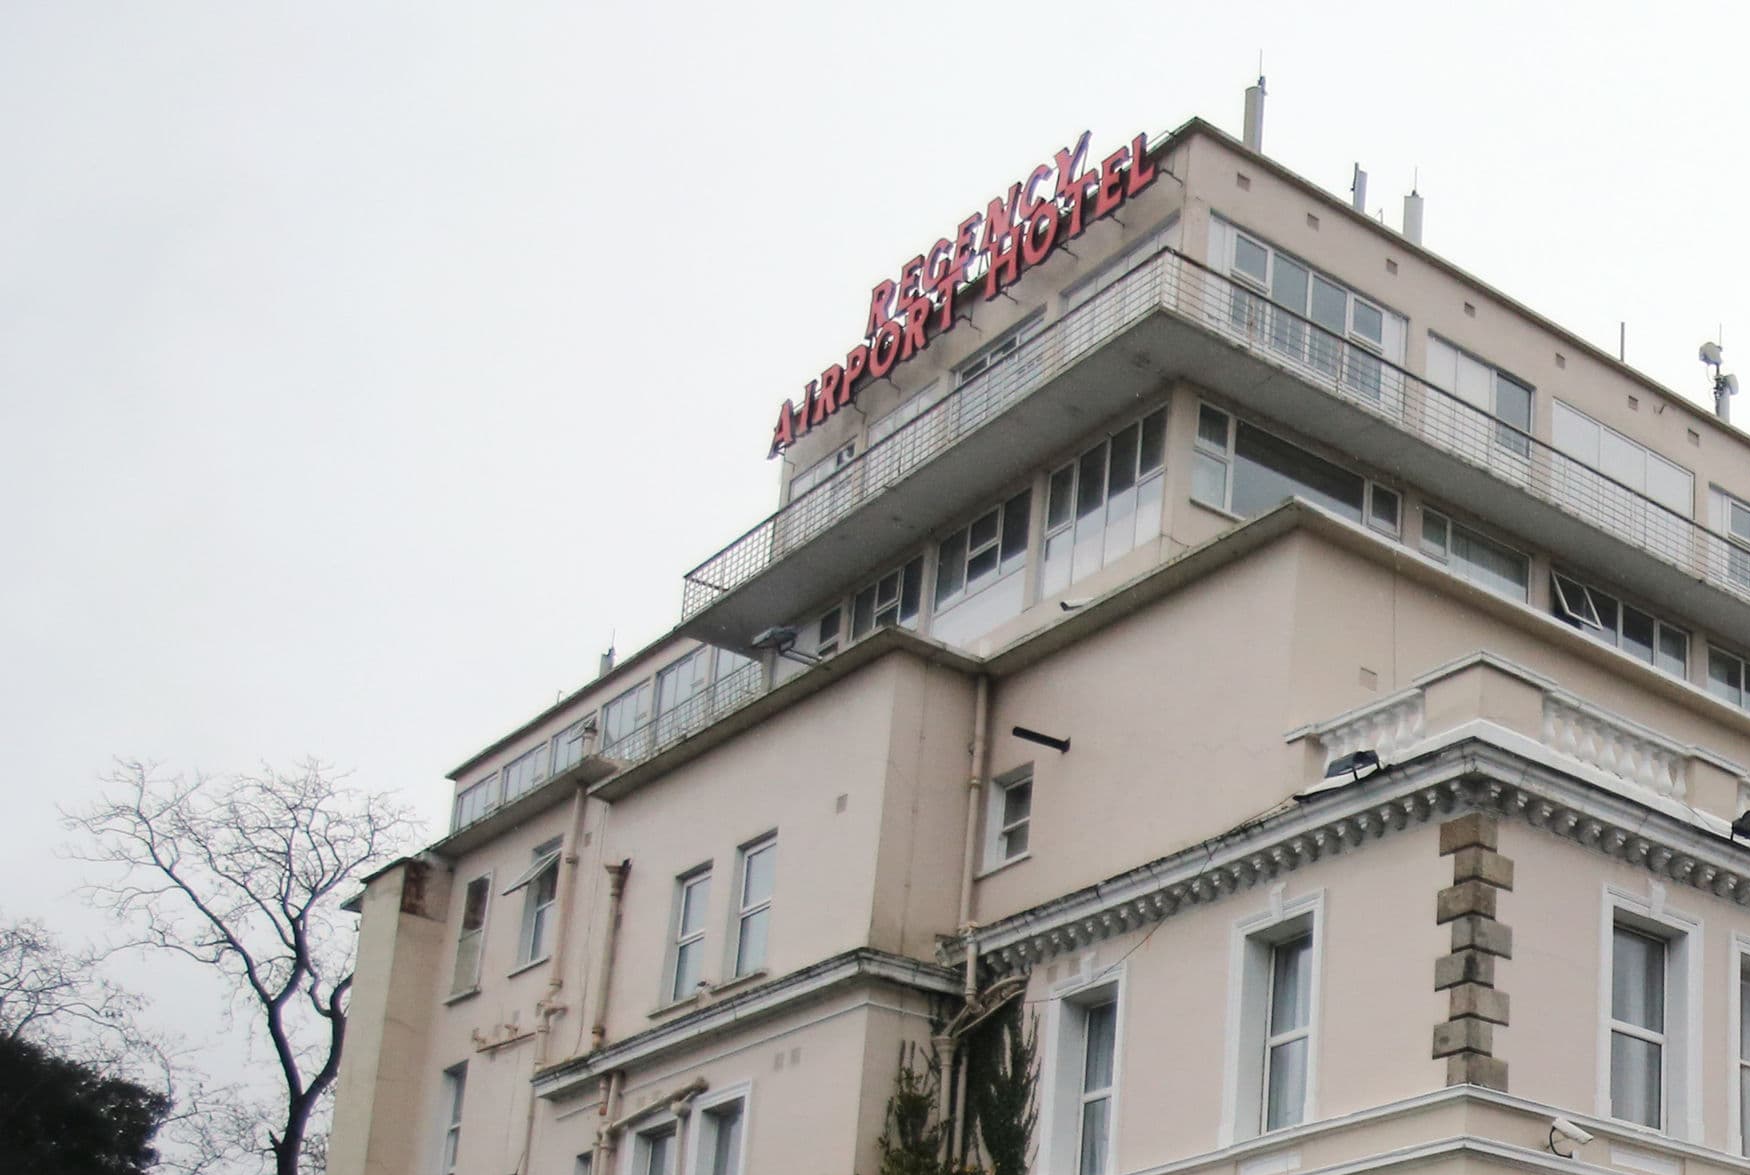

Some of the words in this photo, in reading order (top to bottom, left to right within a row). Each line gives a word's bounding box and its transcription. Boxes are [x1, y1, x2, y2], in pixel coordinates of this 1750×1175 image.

[768, 257, 969, 459] AIRPORT
[984, 132, 1158, 300] HOTEL
[867, 130, 1092, 336] REGENCY
